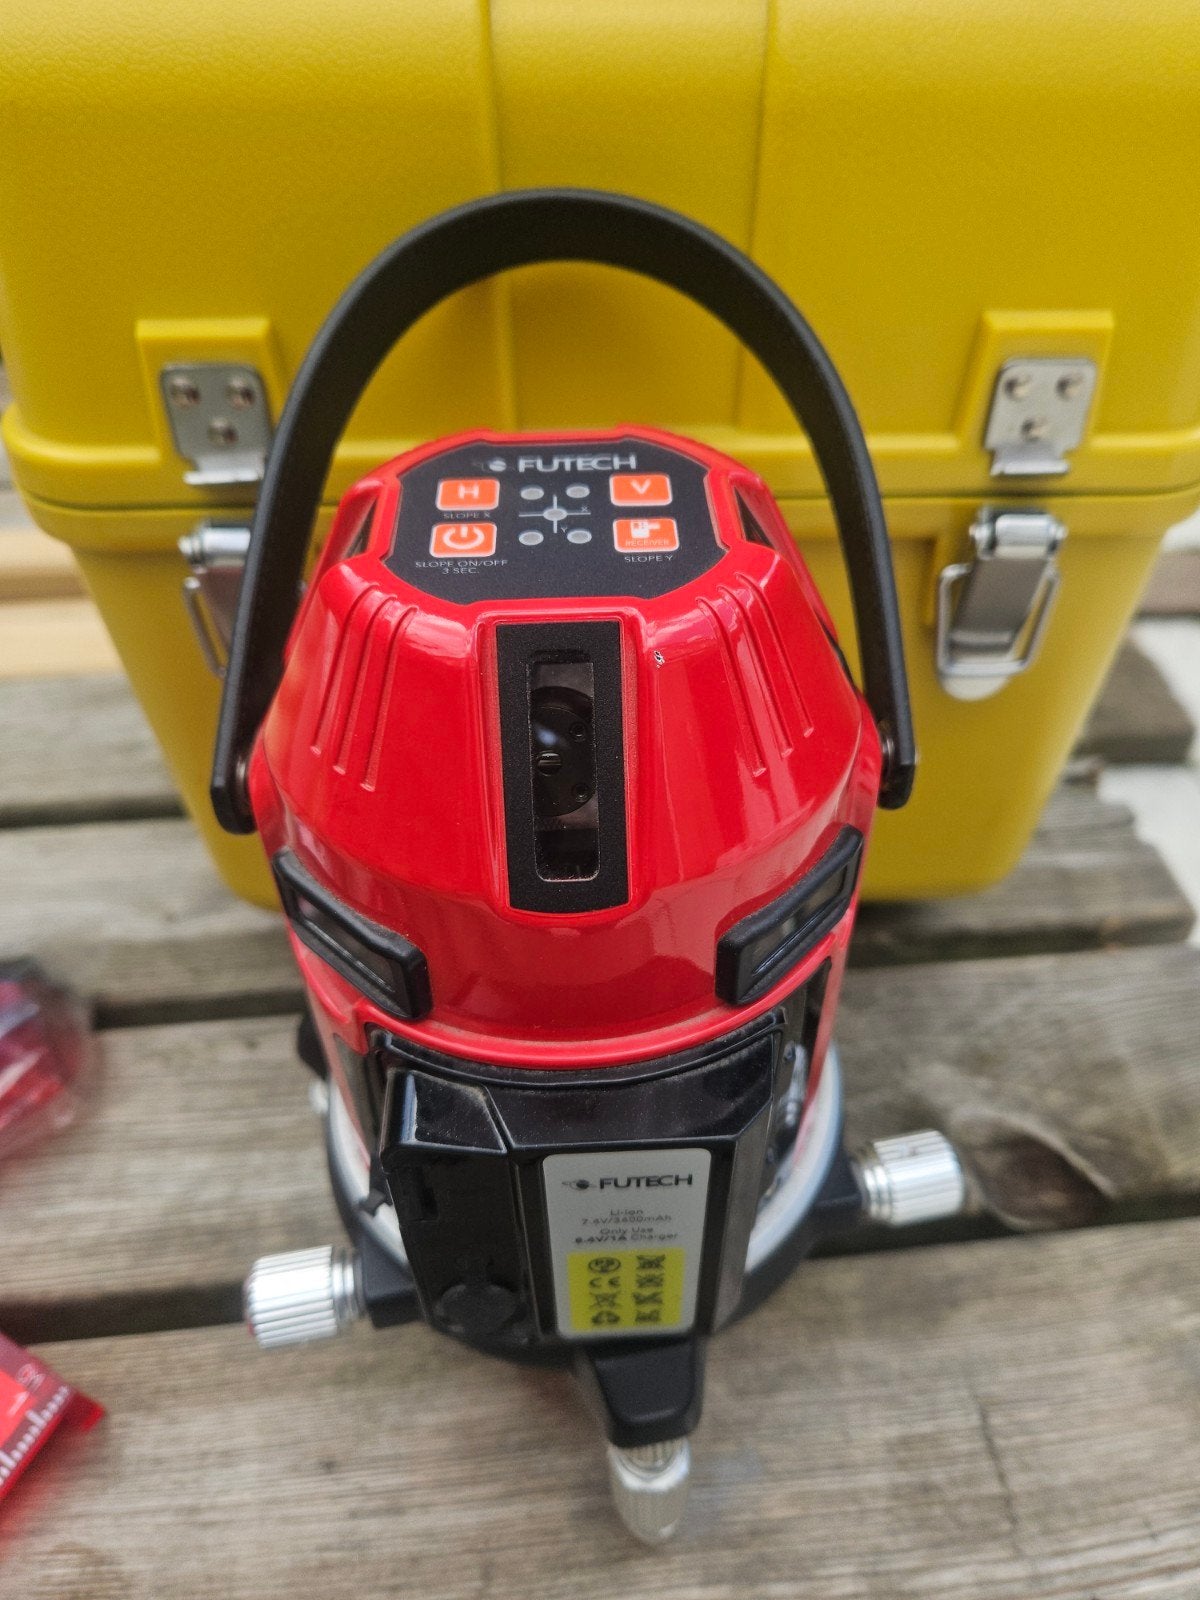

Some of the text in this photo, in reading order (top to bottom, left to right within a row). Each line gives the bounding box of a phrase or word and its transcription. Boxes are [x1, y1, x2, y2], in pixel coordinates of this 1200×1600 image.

[518, 453, 638, 473] FUTECH
[630, 479, 652, 494] V
[457, 483, 480, 500] H
[443, 511, 480, 520] SLOPE
[625, 539, 670, 547] RECEIVER
[624, 555, 663, 563] SLOPE
[415, 560, 508, 568] SLOPE ON/OFF
[453, 567, 481, 575] SEC.
[600, 1174, 693, 1189] FUTECH
[600, 1226, 654, 1235] Only Use
